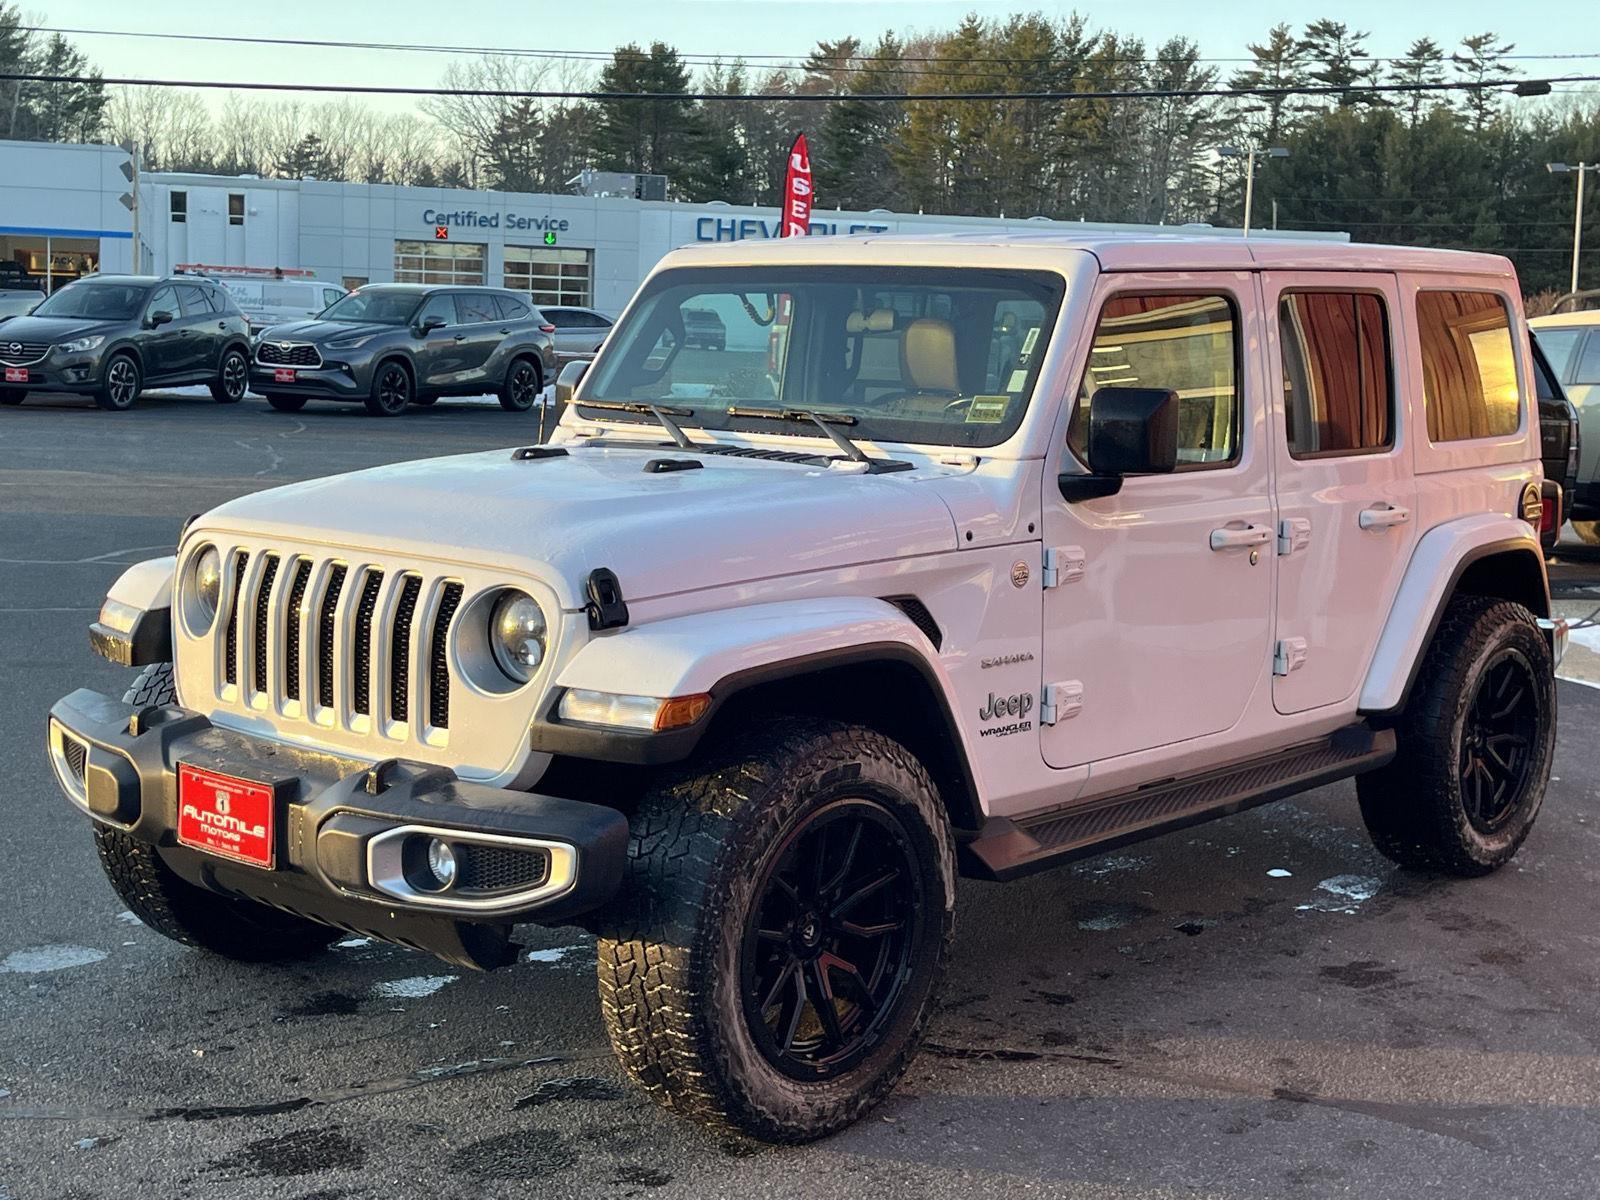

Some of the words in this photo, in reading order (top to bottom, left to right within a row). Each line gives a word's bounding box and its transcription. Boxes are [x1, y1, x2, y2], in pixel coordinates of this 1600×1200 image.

[423, 209, 499, 228] Certified
[506, 213, 570, 232] Service
[979, 691, 1034, 721] Jeep
[979, 721, 1032, 737] WRANGLER
[183, 804, 266, 839] AUTOMILE
[200, 823, 242, 842] MOTORS
